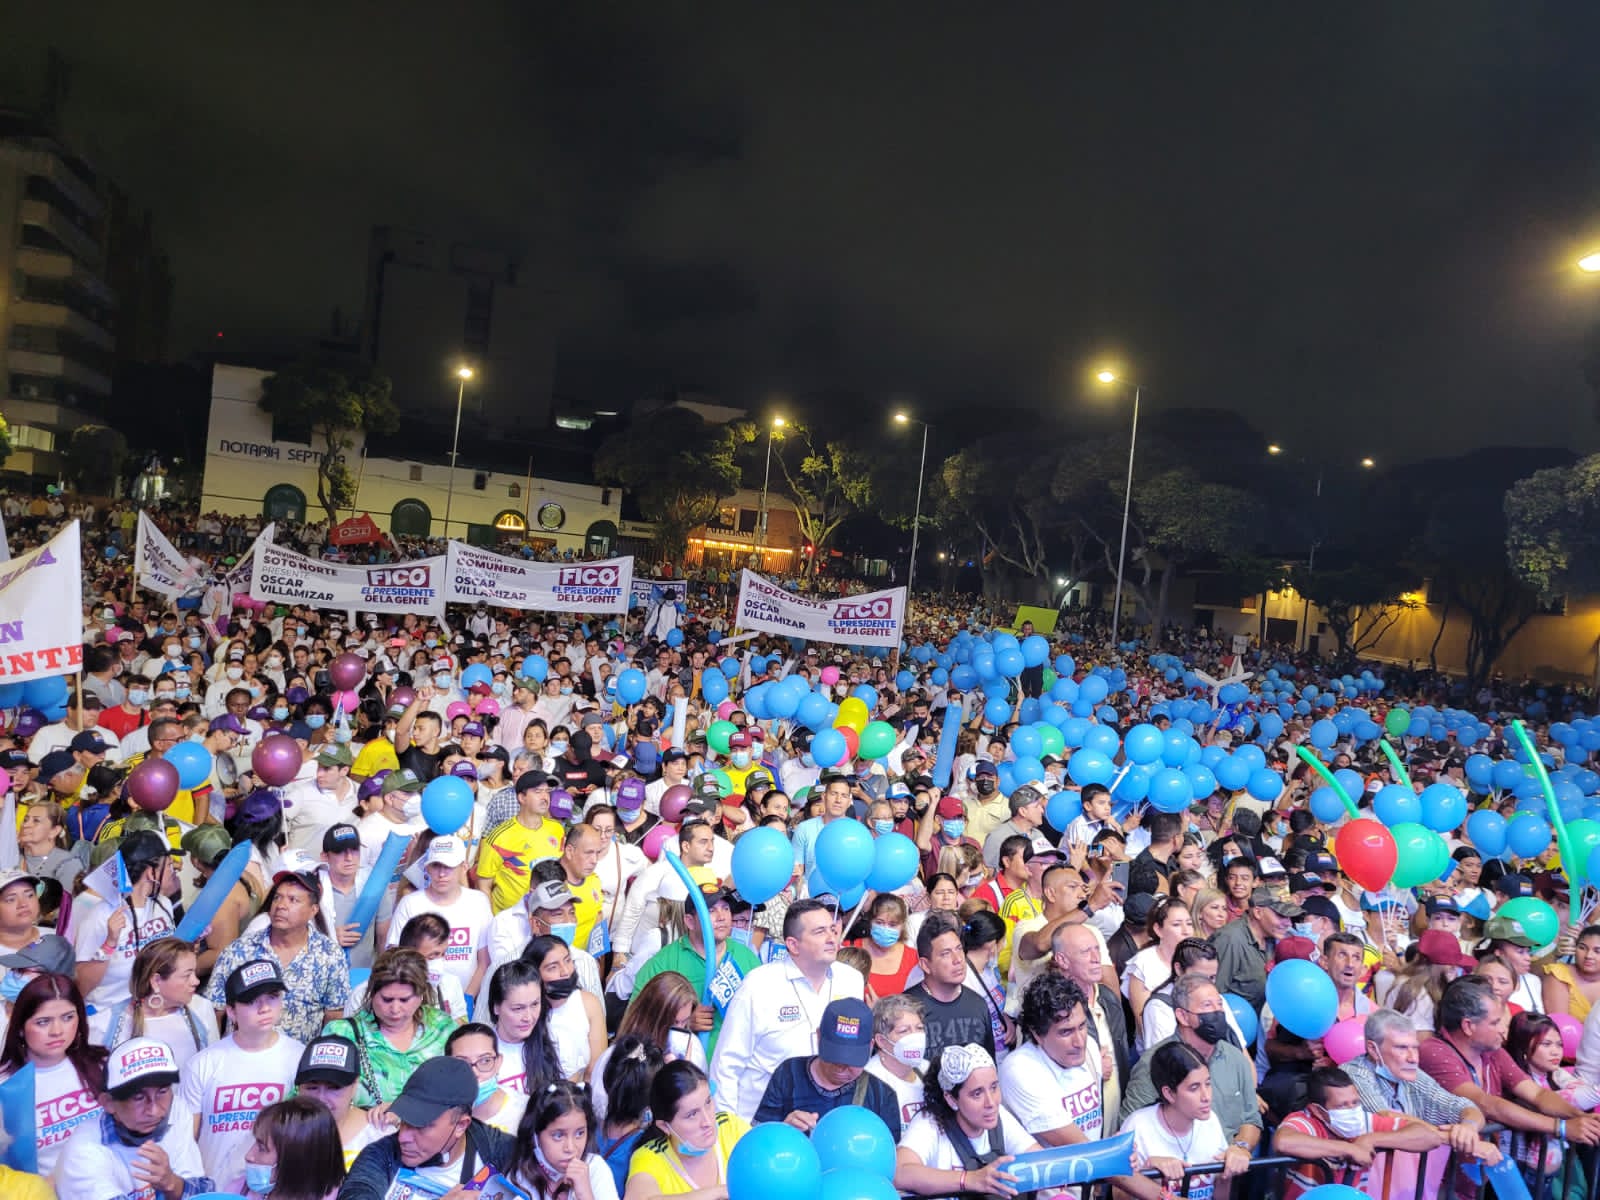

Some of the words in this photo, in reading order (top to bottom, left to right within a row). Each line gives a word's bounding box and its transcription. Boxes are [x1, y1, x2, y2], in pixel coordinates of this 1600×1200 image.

[220, 439, 280, 460] NOTARIA
[263, 556, 297, 569] SOTO
[298, 562, 339, 577] NORTE
[456, 558, 527, 576] COMUNERA
[260, 575, 304, 588] OSCAR
[369, 568, 428, 587] FICO
[454, 575, 497, 588] OSCAR
[561, 567, 618, 585] FICO
[259, 583, 335, 601] VILLAMIZAR
[360, 586, 373, 595] EL
[373, 587, 436, 598] PRESIDENTE
[453, 585, 528, 601] VILLAMIZAR
[552, 585, 564, 594] EL
[564, 586, 623, 597] PRESIDENTE
[748, 579, 829, 611] PIEDECUESTA
[364, 594, 380, 603] DE
[379, 595, 393, 604] LA
[394, 596, 430, 605] GENTE
[557, 593, 571, 602] DE
[571, 594, 585, 603] LA
[585, 594, 617, 605] GENTE
[744, 599, 780, 614] OSCAR
[836, 601, 890, 619] FICO
[743, 608, 807, 630] VILLAMIZAR
[828, 619, 839, 627] EL
[839, 619, 897, 629] PRESIDENTE
[833, 627, 846, 635] DE
[846, 628, 860, 636] LA
[859, 628, 891, 637] GENTE
[837, 1023, 858, 1034] FICO
[123, 1046, 163, 1067] FICO
[317, 1045, 344, 1056] FICO
[903, 1050, 921, 1059] FICO
[216, 1086, 281, 1111] FICO
